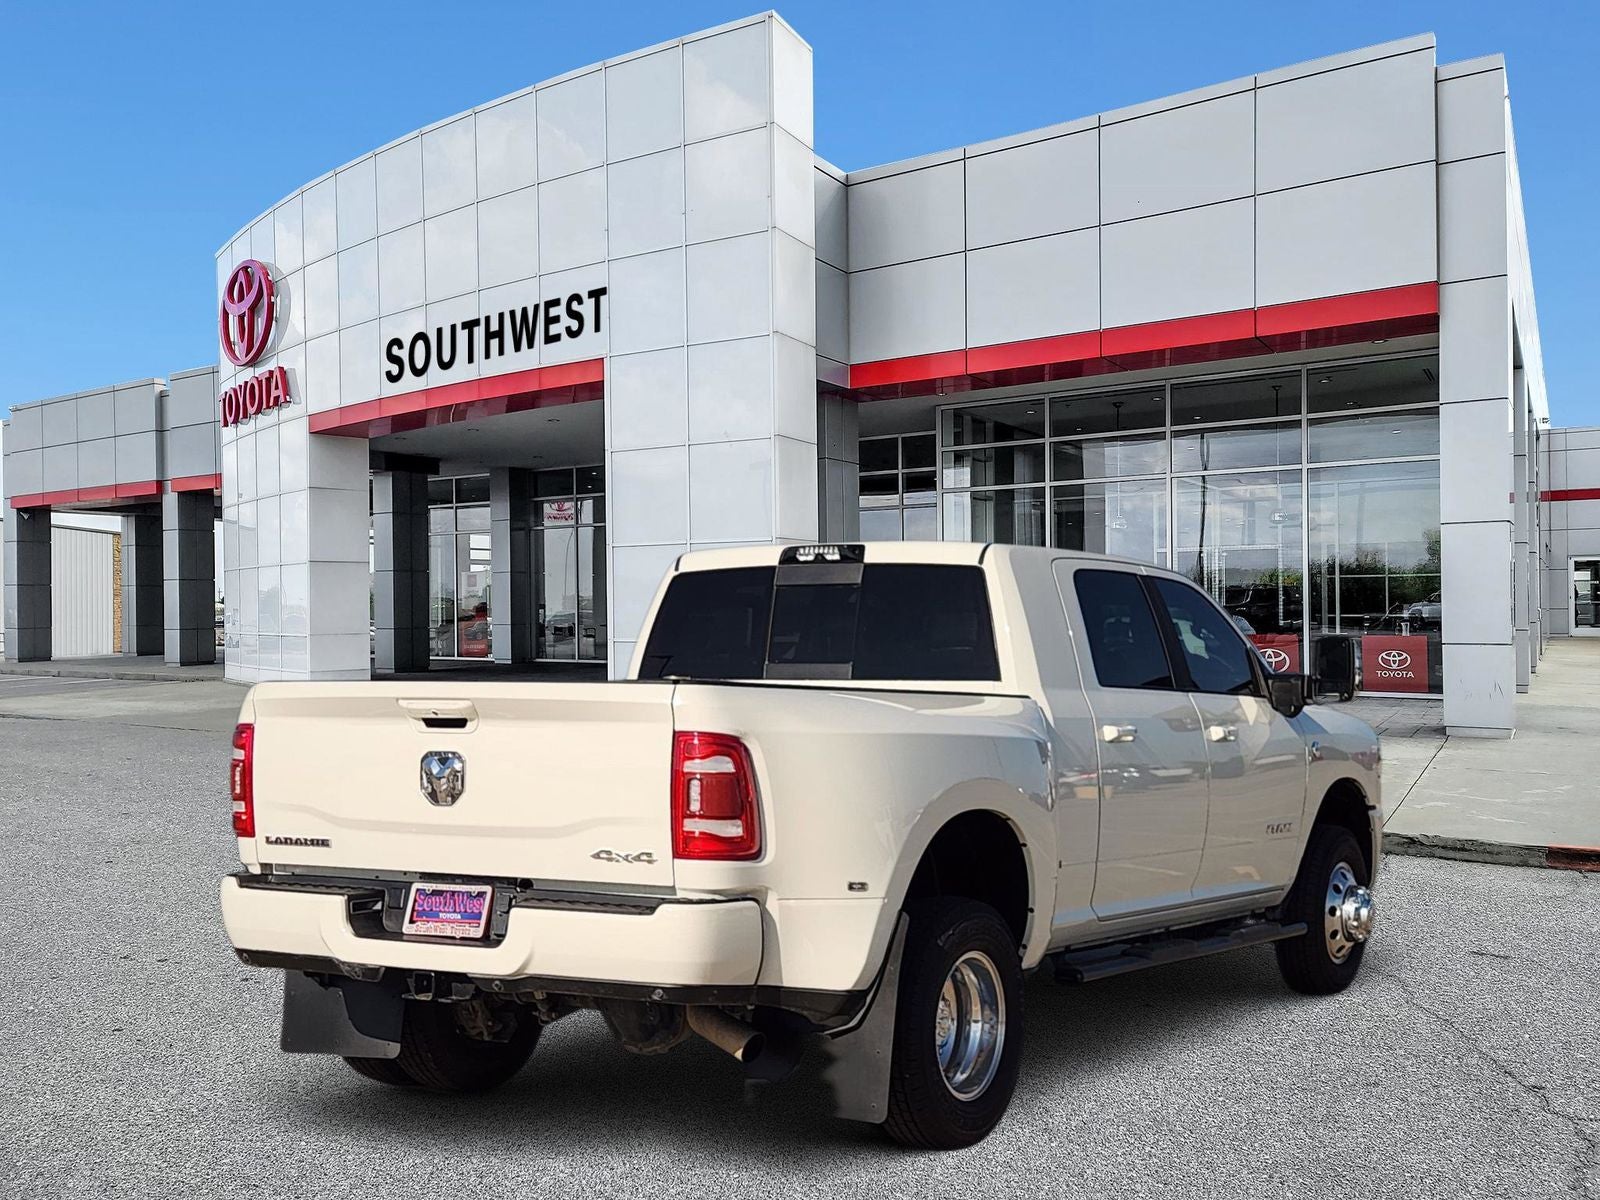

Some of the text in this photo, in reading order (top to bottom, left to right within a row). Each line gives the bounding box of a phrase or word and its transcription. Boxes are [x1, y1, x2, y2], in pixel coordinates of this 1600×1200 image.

[385, 286, 607, 384] SOUTHWEST
[219, 366, 290, 427] TOYOTA
[1375, 670, 1415, 679] TOYOTA
[264, 835, 332, 848] LARAMIE
[439, 912, 462, 920] TOYOTA
